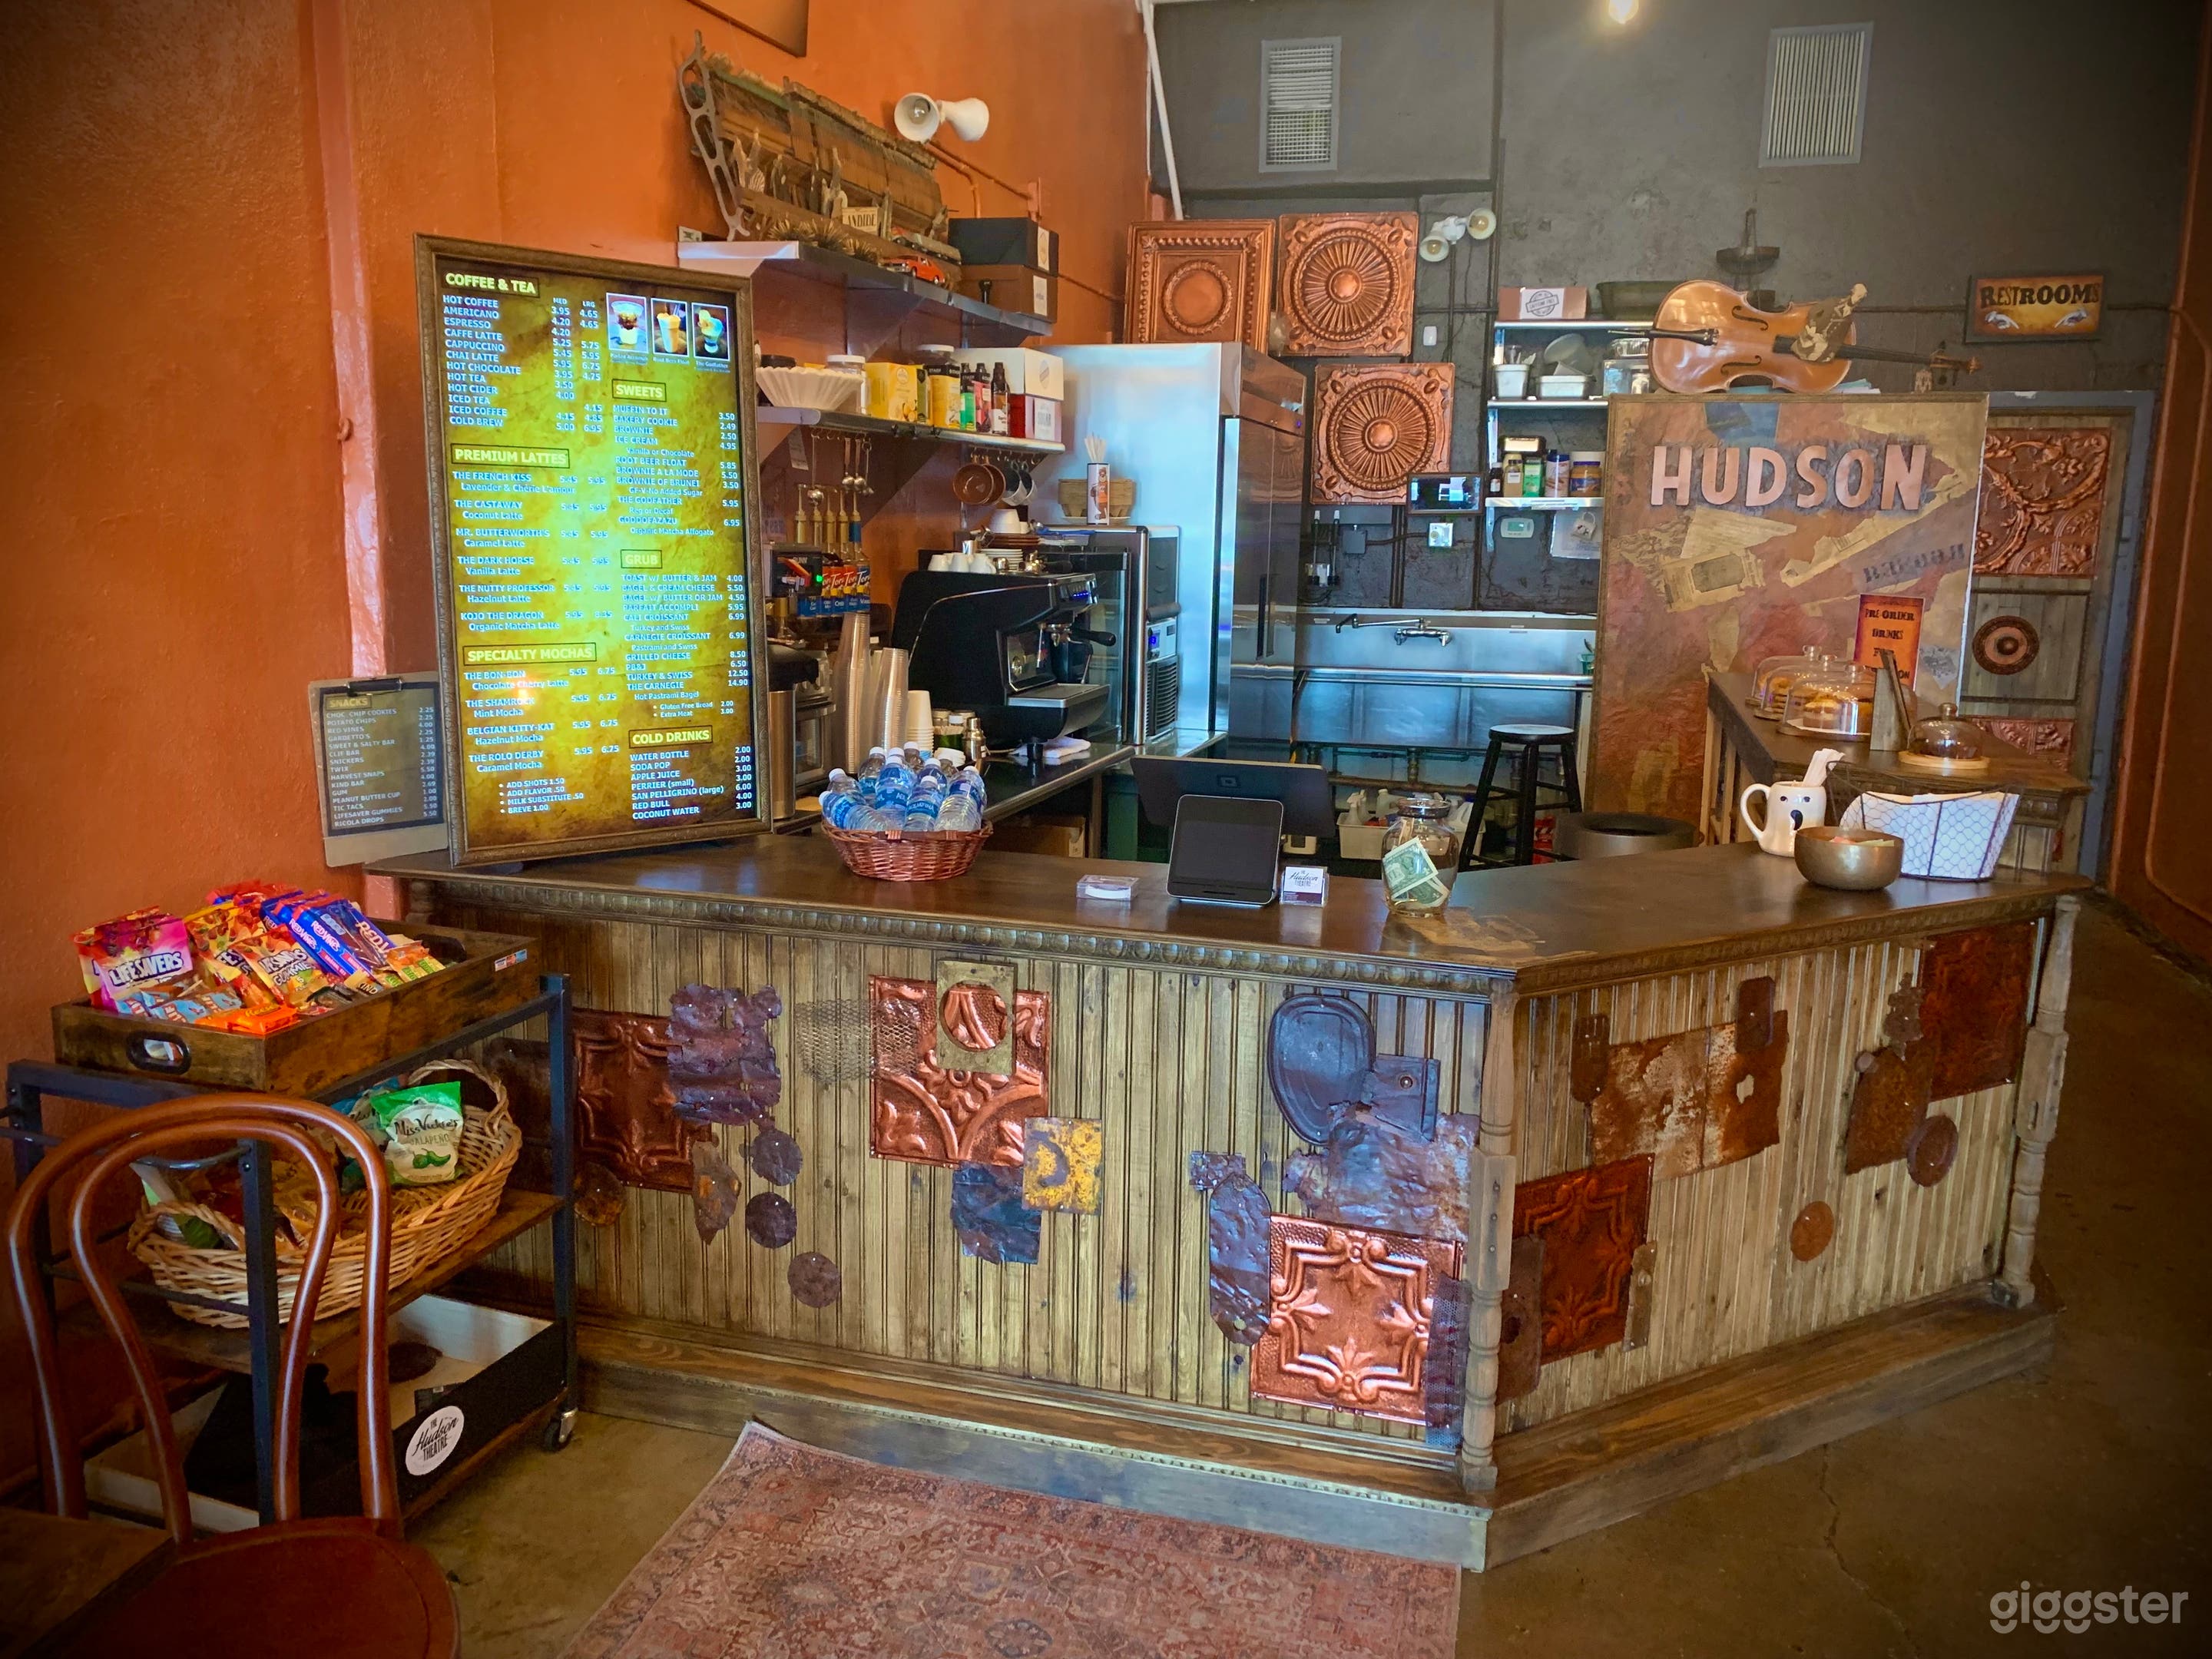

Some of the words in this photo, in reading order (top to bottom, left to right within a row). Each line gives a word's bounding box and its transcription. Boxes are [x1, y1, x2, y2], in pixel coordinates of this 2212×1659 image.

[445, 273, 495, 289] COFFEE
[498, 279, 508, 291] &
[511, 280, 536, 293] TEA
[443, 295, 462, 303] HOT
[464, 296, 498, 307] COFFEE
[1980, 283, 2101, 309] RESTROOMS
[443, 306, 499, 319] AMERICANO
[444, 317, 491, 329] ESPRESSO
[445, 329, 472, 338] CAFFE
[475, 331, 502, 340] LATTE
[445, 339, 505, 352] CAPPUCCINO
[553, 339, 571, 347] 5.25
[581, 341, 599, 349] 5.75
[446, 351, 469, 360] CHAI
[472, 353, 498, 362] LATTE
[447, 362, 465, 371] HOT
[469, 363, 522, 375] CHOCOLATE
[448, 373, 466, 382] HOT
[448, 384, 467, 392] HOT
[470, 385, 498, 394] CIDER
[616, 383, 664, 398] SWEETS
[449, 395, 471, 403] ICED
[473, 396, 490, 405] TEA
[449, 406, 472, 414] ICED
[475, 407, 508, 416] COFFEE
[450, 416, 474, 426] COLD
[477, 418, 503, 427] BREW
[614, 416, 644, 424] BAKERY
[647, 418, 677, 426] COOKIE
[614, 426, 653, 435] BROWNIE
[455, 449, 518, 462] PREMIUM
[522, 452, 567, 464] LATTES
[453, 471, 471, 479] THE
[473, 472, 508, 481] FRENCH
[511, 473, 531, 482] KISS
[1650, 443, 1926, 511] HUDSON
[625, 555, 657, 565] GRUB
[468, 649, 536, 661] SPECIALTY
[540, 647, 592, 659] MOCHAS
[329, 697, 368, 708] SNACKS
[467, 727, 509, 735] BELGIAN
[511, 724, 555, 733] KITTY-KAT
[633, 733, 663, 744] COLD
[667, 730, 710, 743] DRINKS
[488, 753, 513, 761] ROLO
[515, 750, 543, 760] DERBY
[661, 750, 689, 760] BOTTLE
[477, 763, 512, 772] Caramel
[515, 761, 542, 770] Mocha
[657, 770, 680, 779] JUICE
[631, 781, 666, 790] PERRIER
[667, 779, 694, 788] (small)
[650, 788, 697, 798] PELLIGRINO
[699, 786, 724, 796] (large)
[528, 793, 571, 803] SUBSTITUTE
[633, 810, 671, 819] COCONUT
[672, 806, 700, 816] WATER
[412, 1417, 459, 1457] Hudson
[423, 1435, 448, 1462] THEATRE
